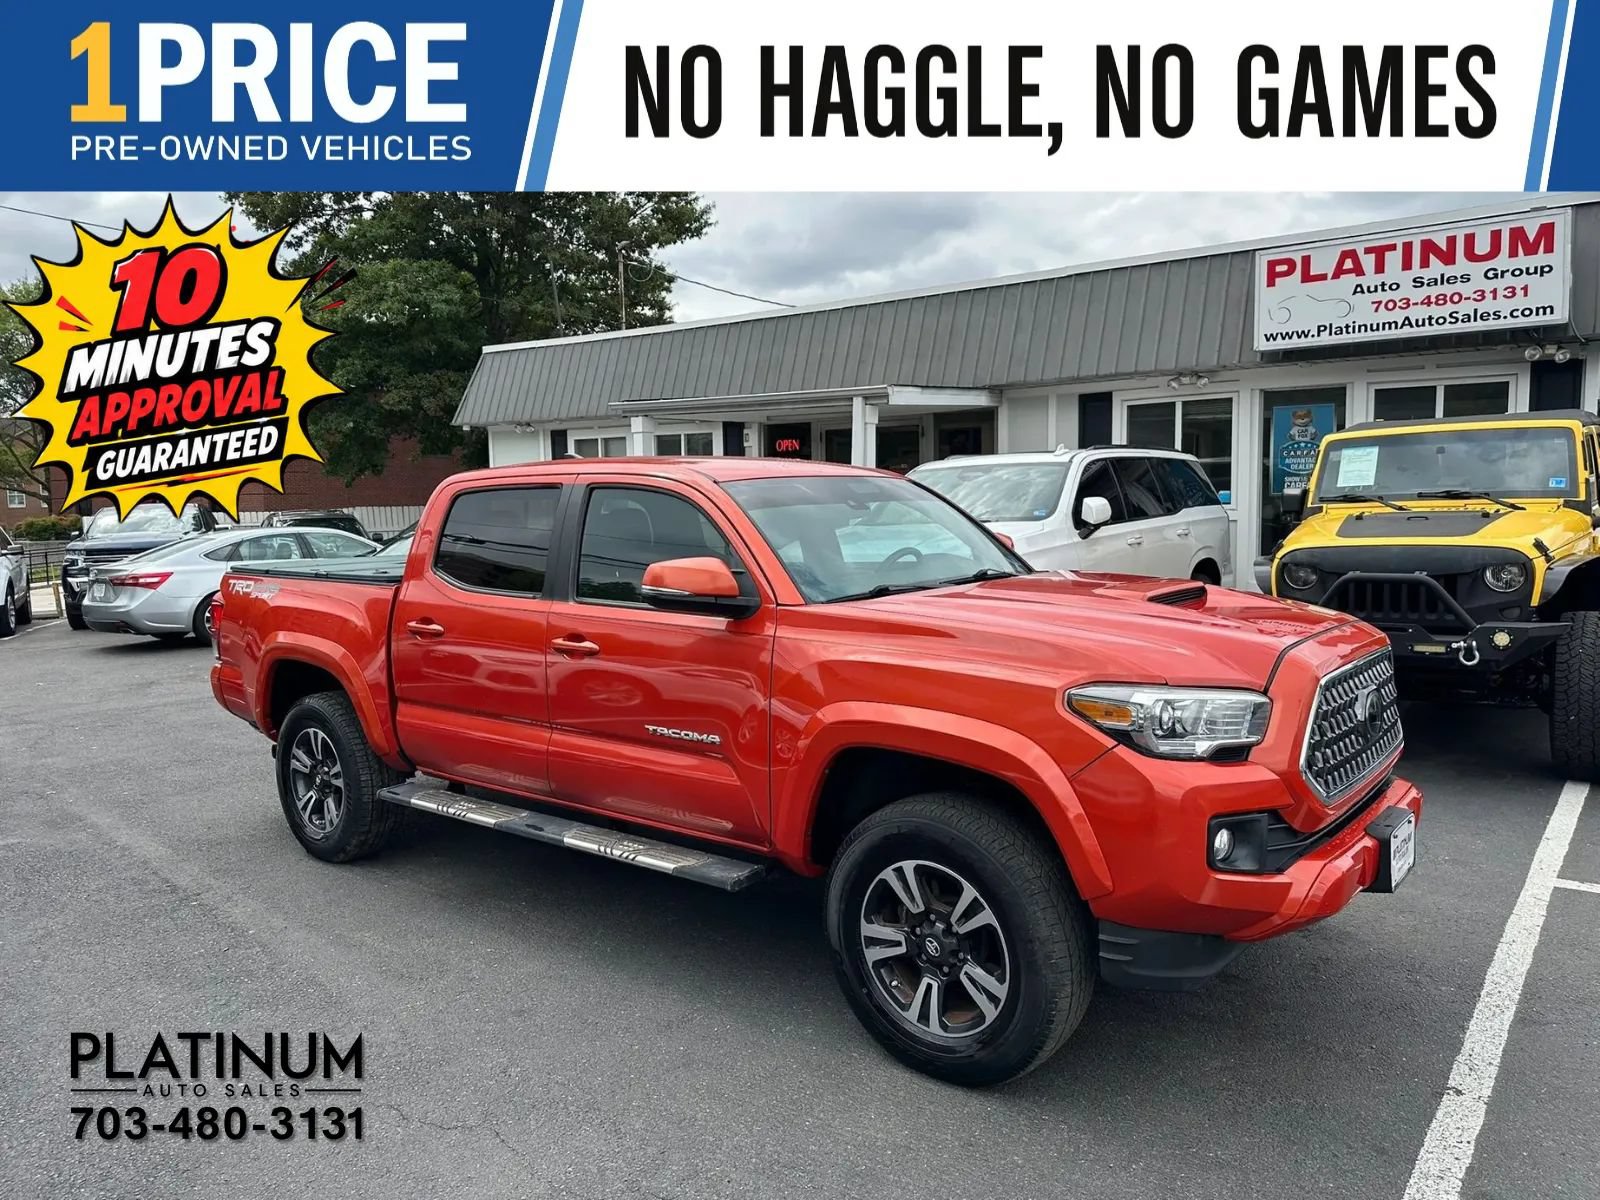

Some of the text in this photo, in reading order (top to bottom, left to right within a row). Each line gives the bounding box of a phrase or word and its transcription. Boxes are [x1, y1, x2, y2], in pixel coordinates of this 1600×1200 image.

[1265, 221, 1556, 288] PLATINUM
[1352, 263, 1553, 296] Auto Sales Group
[1371, 284, 1529, 313] 703-480-3131
[1264, 303, 1554, 342] www.PlatinumAutoSales.com
[775, 439, 800, 452] OPEN
[1283, 449, 1319, 457] CARFA
[228, 579, 255, 596] TRD
[644, 724, 721, 744] TACOMA
